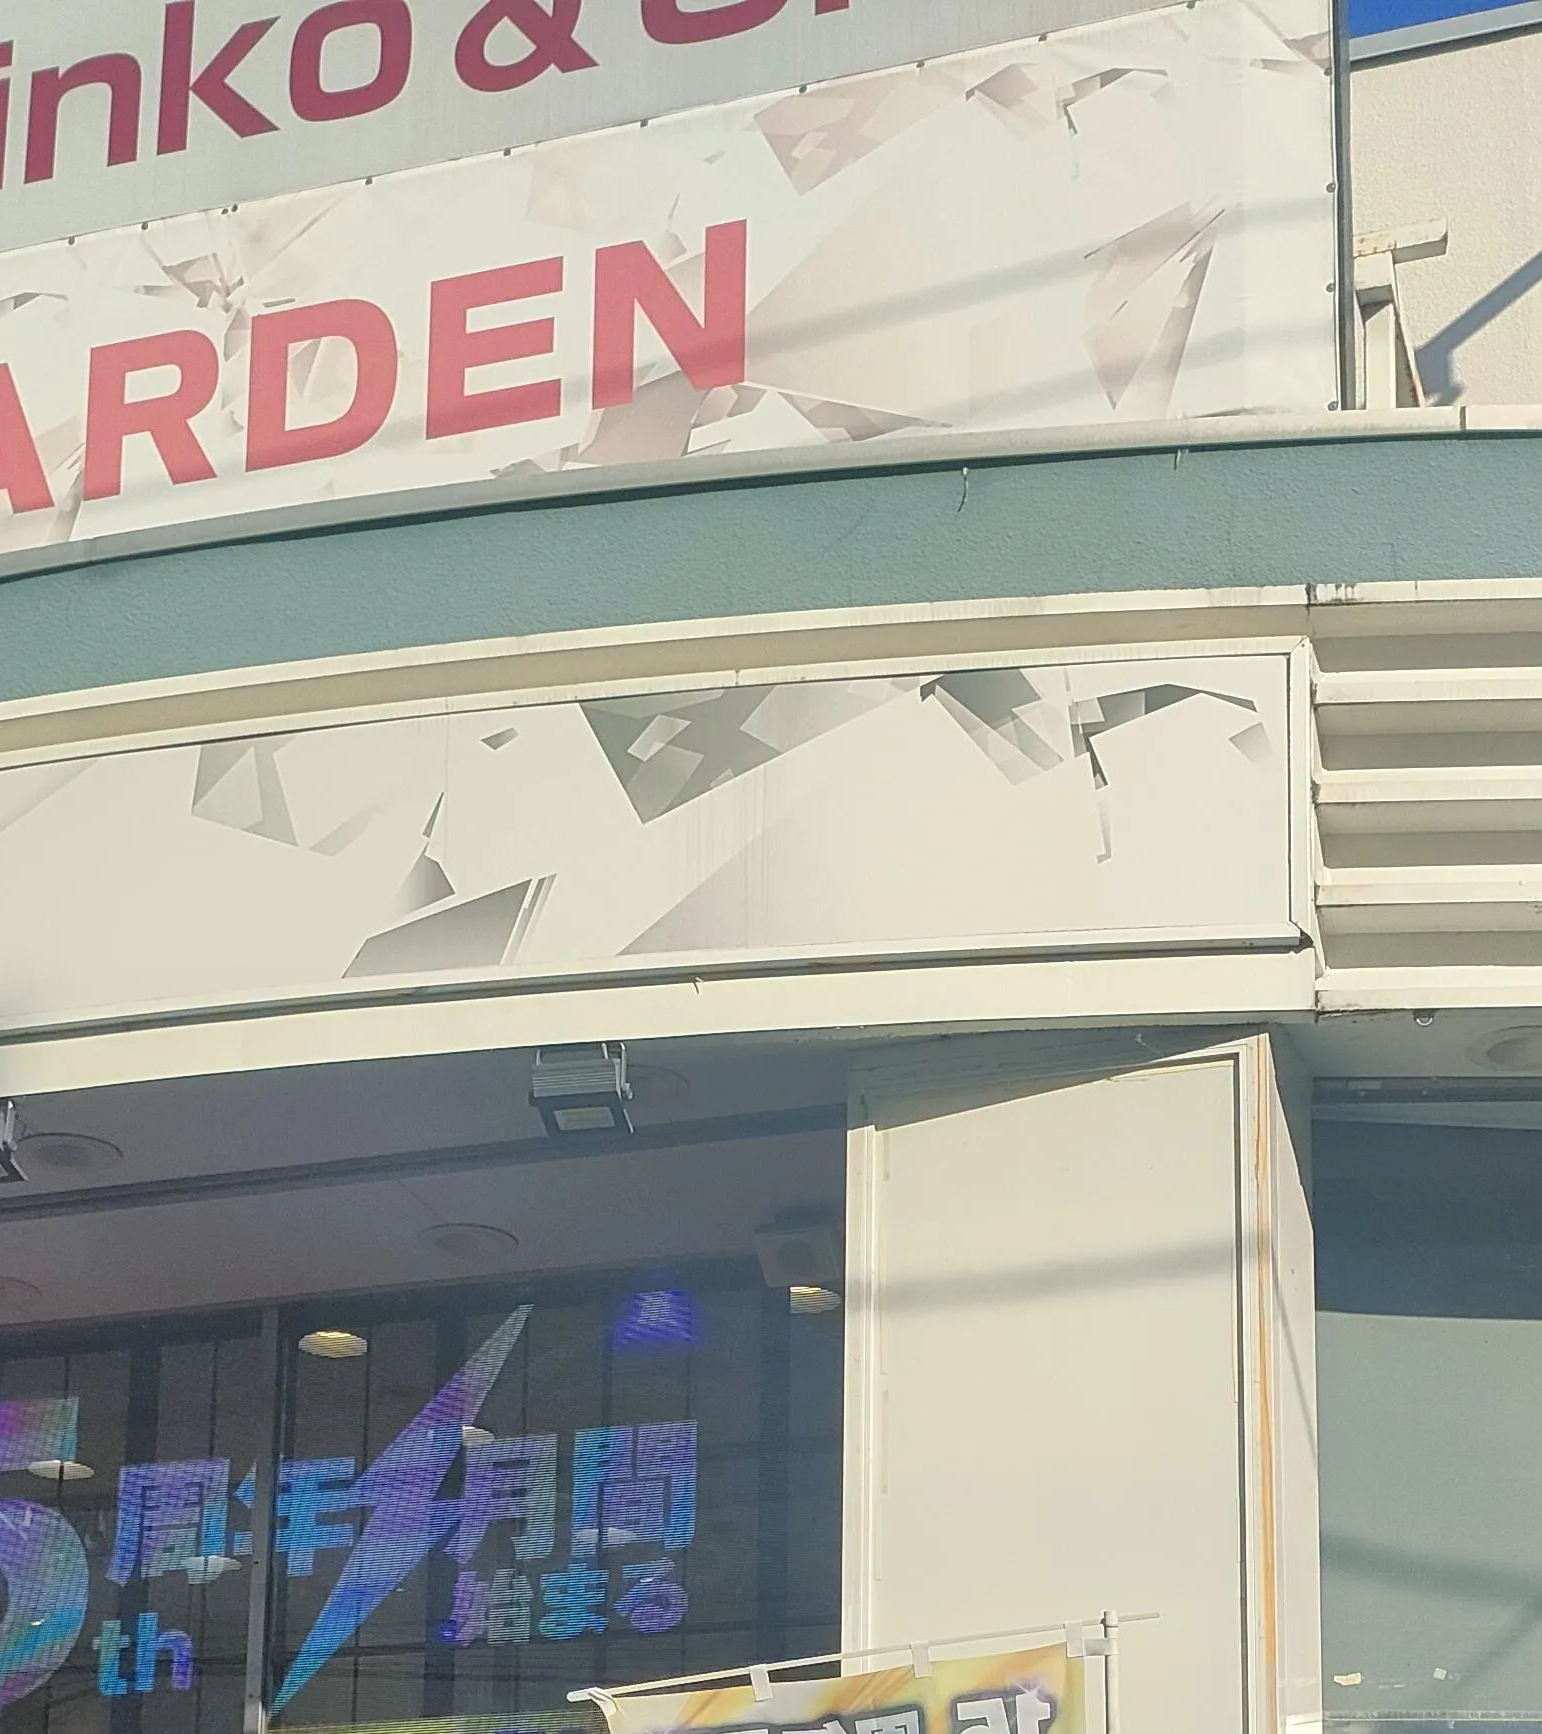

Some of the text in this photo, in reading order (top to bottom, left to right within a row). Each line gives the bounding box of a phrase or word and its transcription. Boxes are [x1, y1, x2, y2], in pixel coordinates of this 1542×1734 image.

[454, 0, 599, 93] &
[440, 1555, 690, 1648] 始まる
[92, 1612, 195, 1696] th
